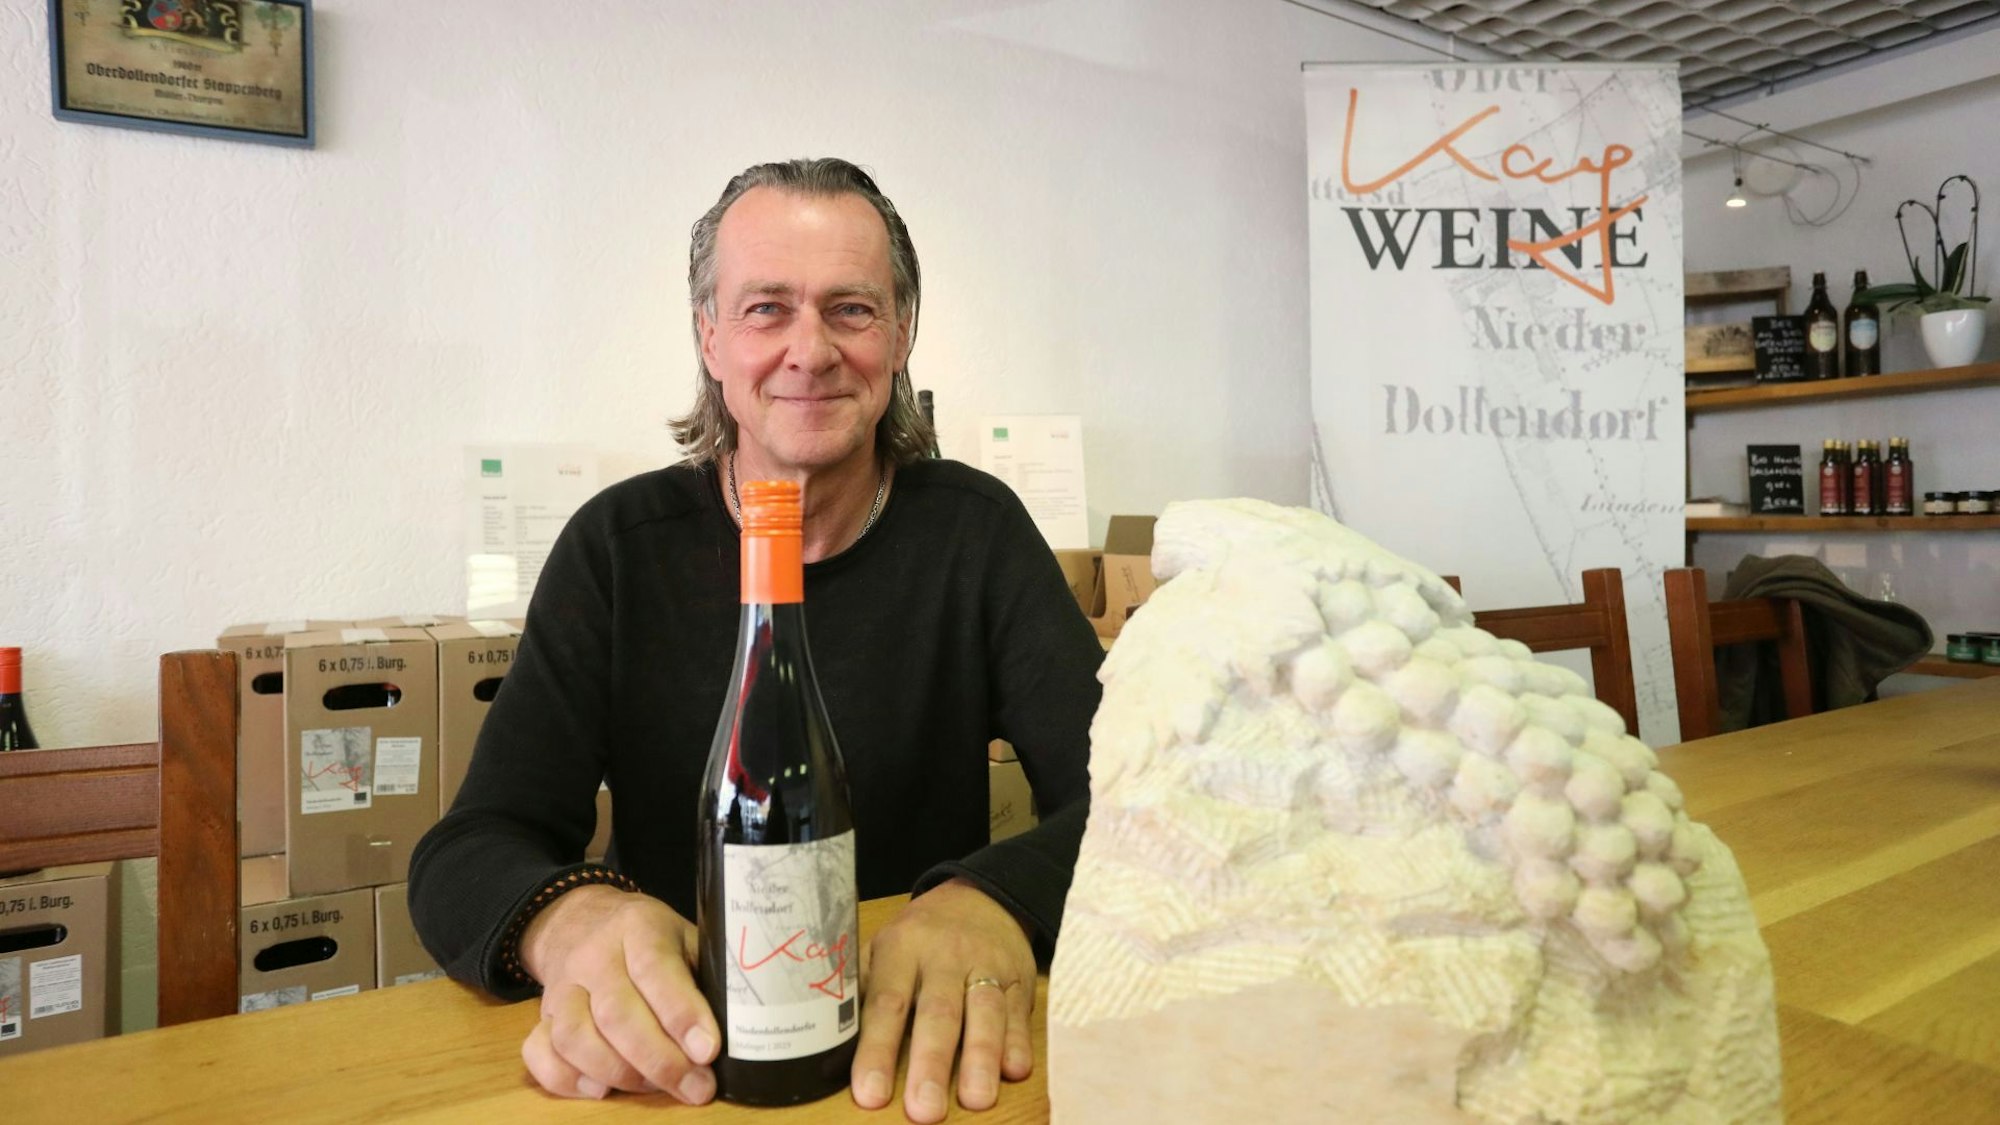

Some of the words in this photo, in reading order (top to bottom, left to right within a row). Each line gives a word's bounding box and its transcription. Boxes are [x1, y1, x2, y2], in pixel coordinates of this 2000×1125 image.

[1341, 206, 1649, 271] WEINE
[1471, 304, 1647, 352] Nieder
[1382, 384, 1668, 441] Dollendorf
[246, 648, 253, 660] 6
[256, 650, 262, 659] x
[468, 650, 475, 664] 6
[478, 653, 484, 663] x
[486, 649, 509, 666] 0,75
[319, 659, 326, 672] 6
[329, 662, 337, 671] x
[339, 658, 365, 673] 0,75
[377, 656, 407, 671] Burg.
[40, 895, 74, 909] Burg.
[250, 920, 259, 934] 6
[262, 921, 269, 932] x
[272, 913, 298, 932] 0,75
[302, 912, 309, 926] l.
[312, 910, 344, 924] Burg.
